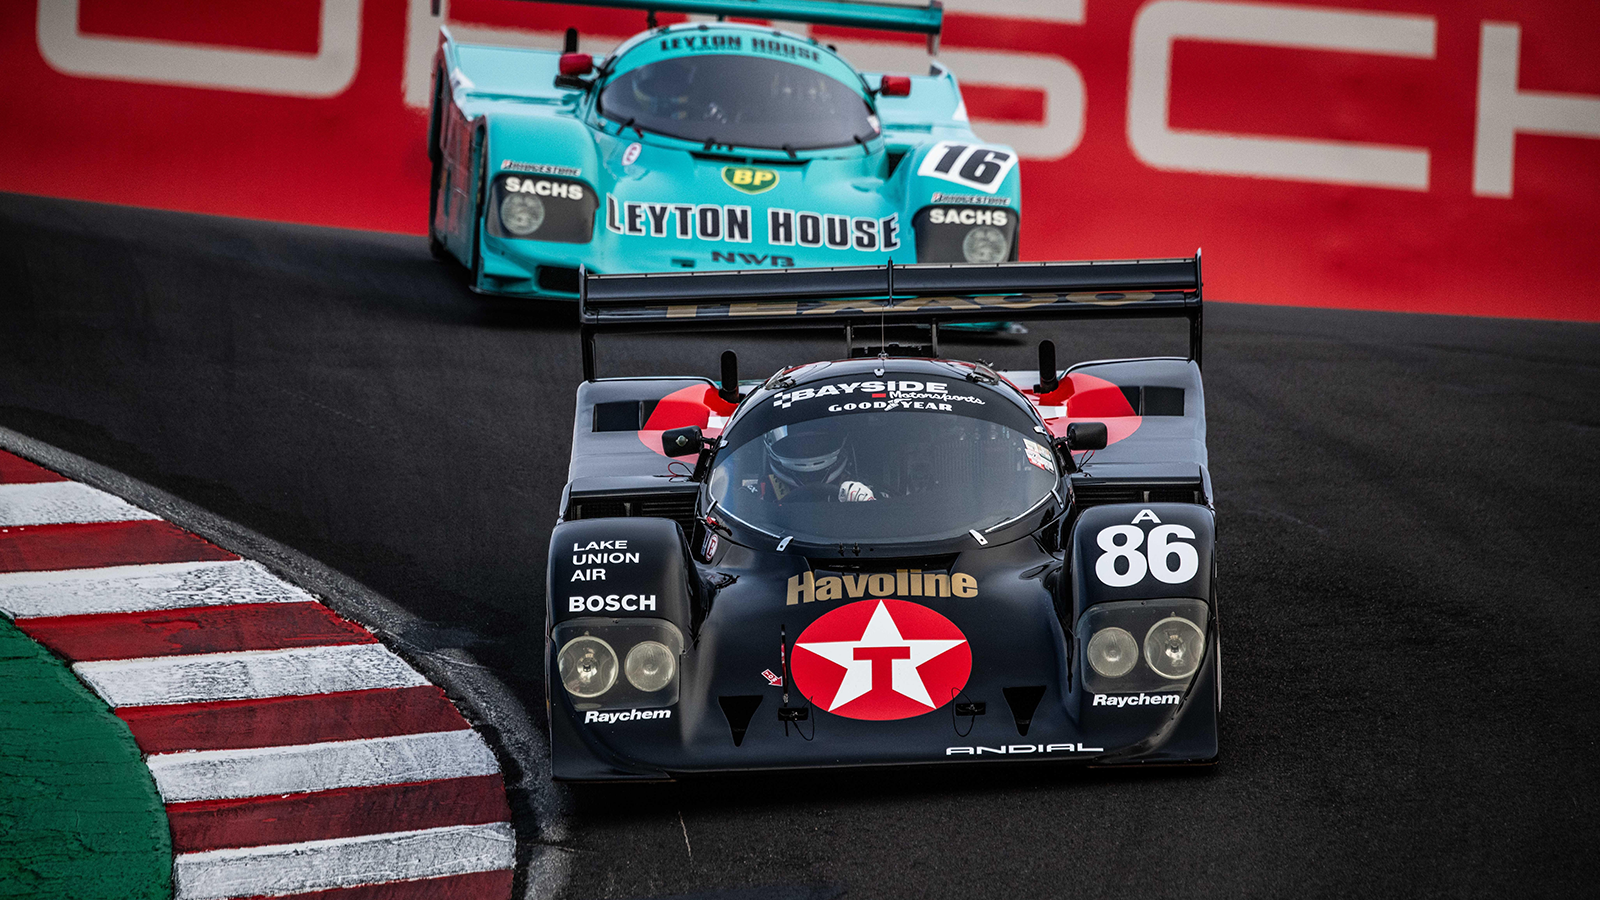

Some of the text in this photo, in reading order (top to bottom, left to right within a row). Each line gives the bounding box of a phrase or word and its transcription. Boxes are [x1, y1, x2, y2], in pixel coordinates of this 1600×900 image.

[660, 36, 741, 51] LEYTON
[752, 38, 821, 61] HOUSE
[934, 145, 1010, 185] 16
[733, 169, 774, 185] BP
[505, 176, 584, 200] SACHS
[606, 192, 900, 252] LEYTON HOUSE
[929, 208, 1008, 226] SACHS
[711, 251, 795, 267] NWB
[790, 381, 949, 403] BAYSIDE
[888, 390, 986, 405] Motorsports
[1130, 508, 1162, 524] A
[573, 540, 628, 552] LAKE
[572, 552, 640, 566] UNION
[1095, 523, 1199, 588] 86
[570, 568, 606, 582] AIR
[786, 568, 979, 606] Havoline
[568, 594, 657, 613] BOSCH
[853, 645, 911, 691] T
[1092, 694, 1181, 708] Raychem
[584, 708, 672, 724] Raychem
[945, 743, 1104, 756] ANDIAL
